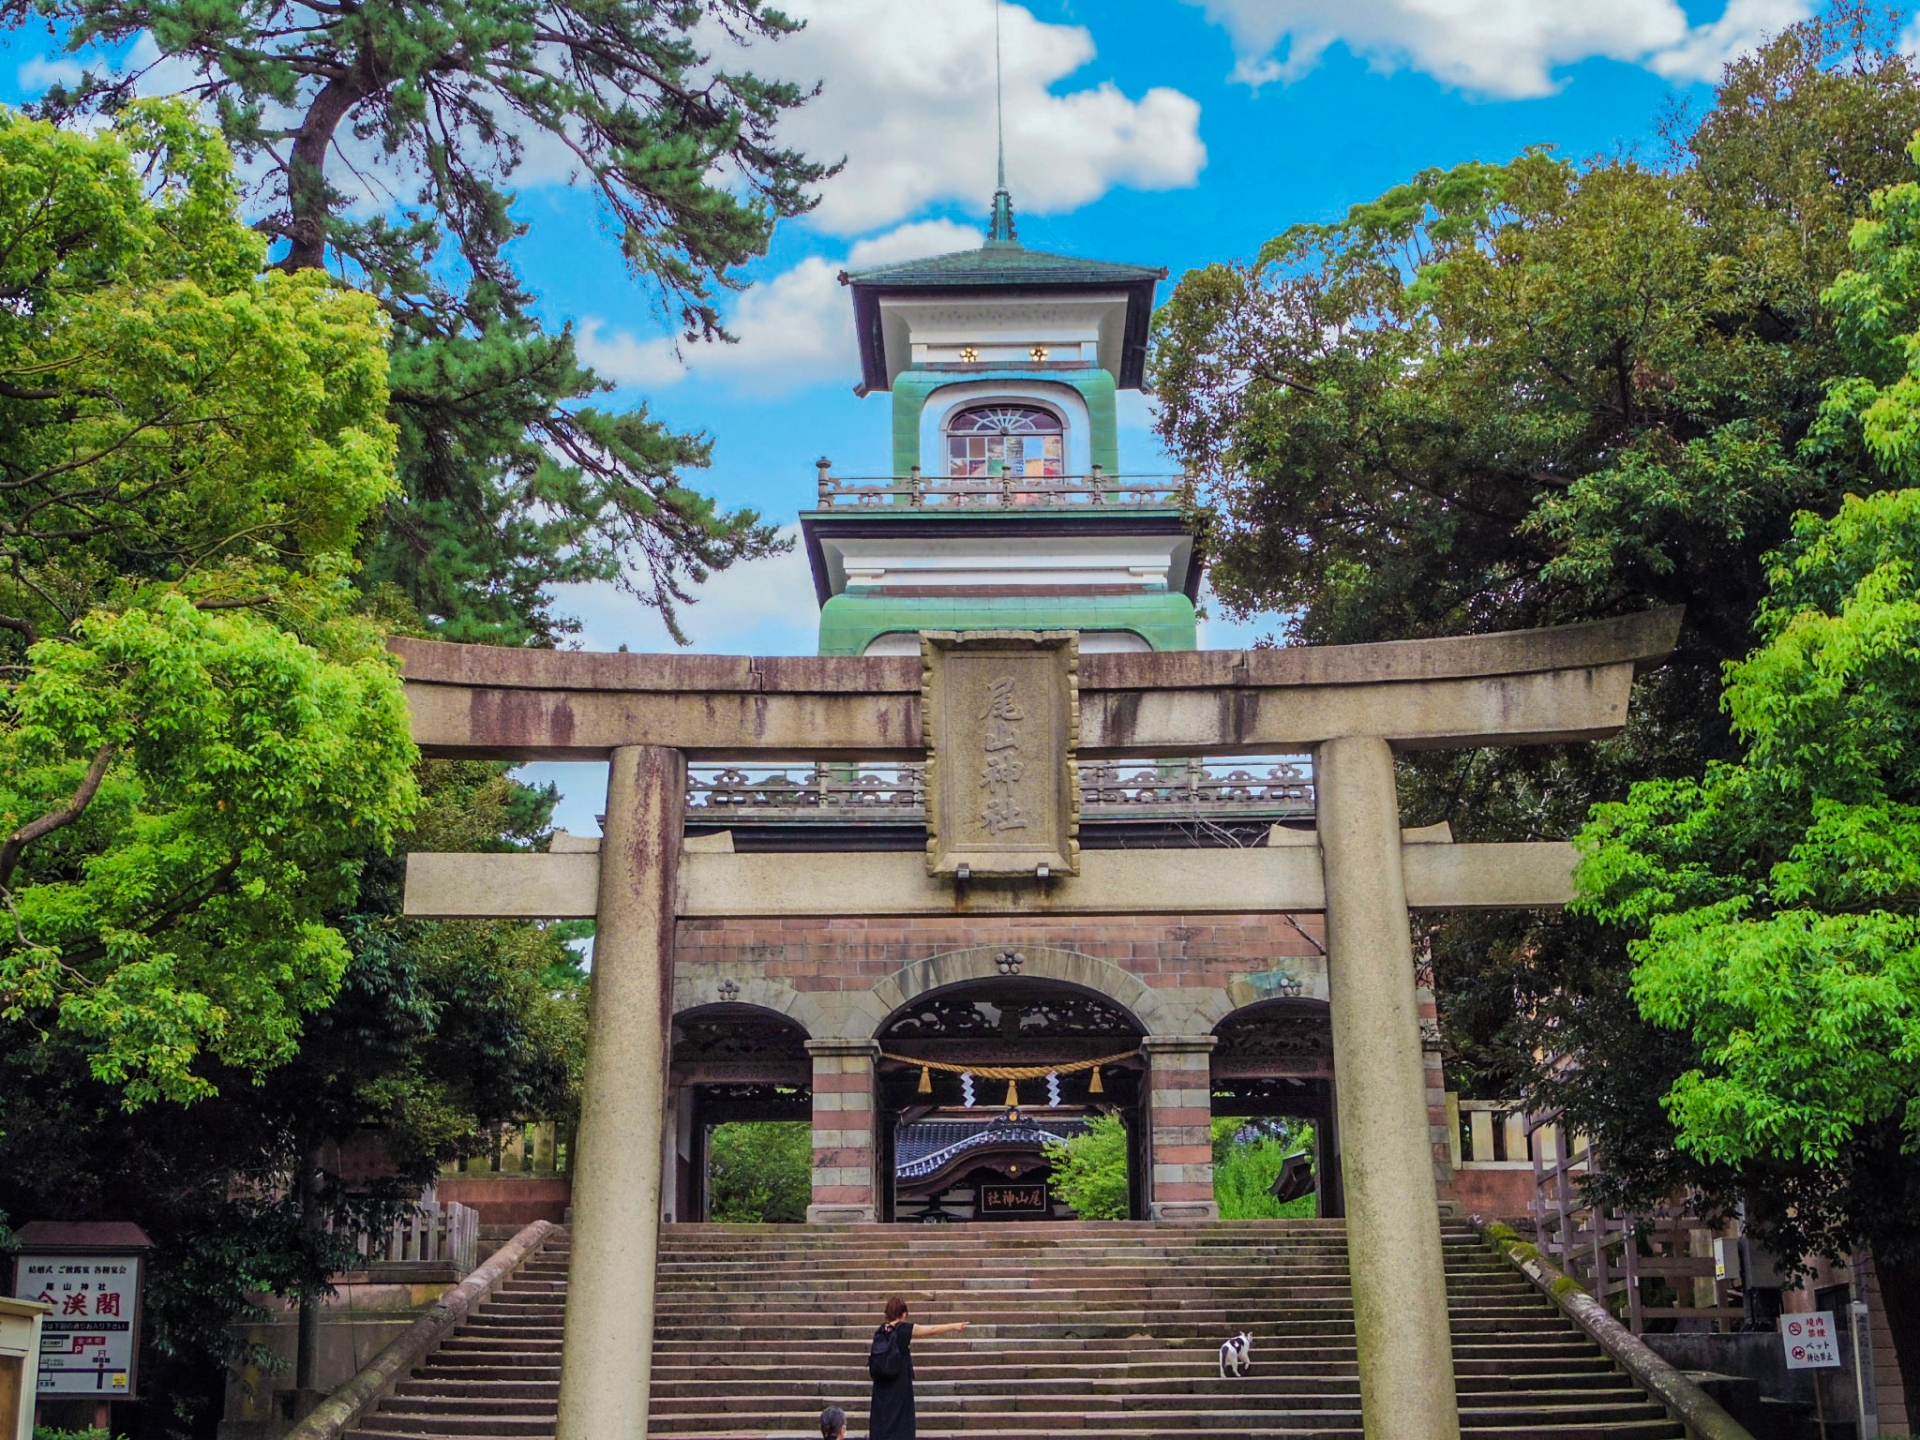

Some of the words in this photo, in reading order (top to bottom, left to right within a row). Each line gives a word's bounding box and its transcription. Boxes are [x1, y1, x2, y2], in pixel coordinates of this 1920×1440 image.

[979, 675, 1028, 836] 尾山神社
[28, 1265, 53, 1274] 結婚式
[45, 1283, 107, 1291] 尾山神社
[1805, 1317, 1824, 1327] 境内
[1808, 1328, 1826, 1338] 禁煙
[74, 1345, 82, 1353] P
[1806, 1340, 1830, 1350] ペット
